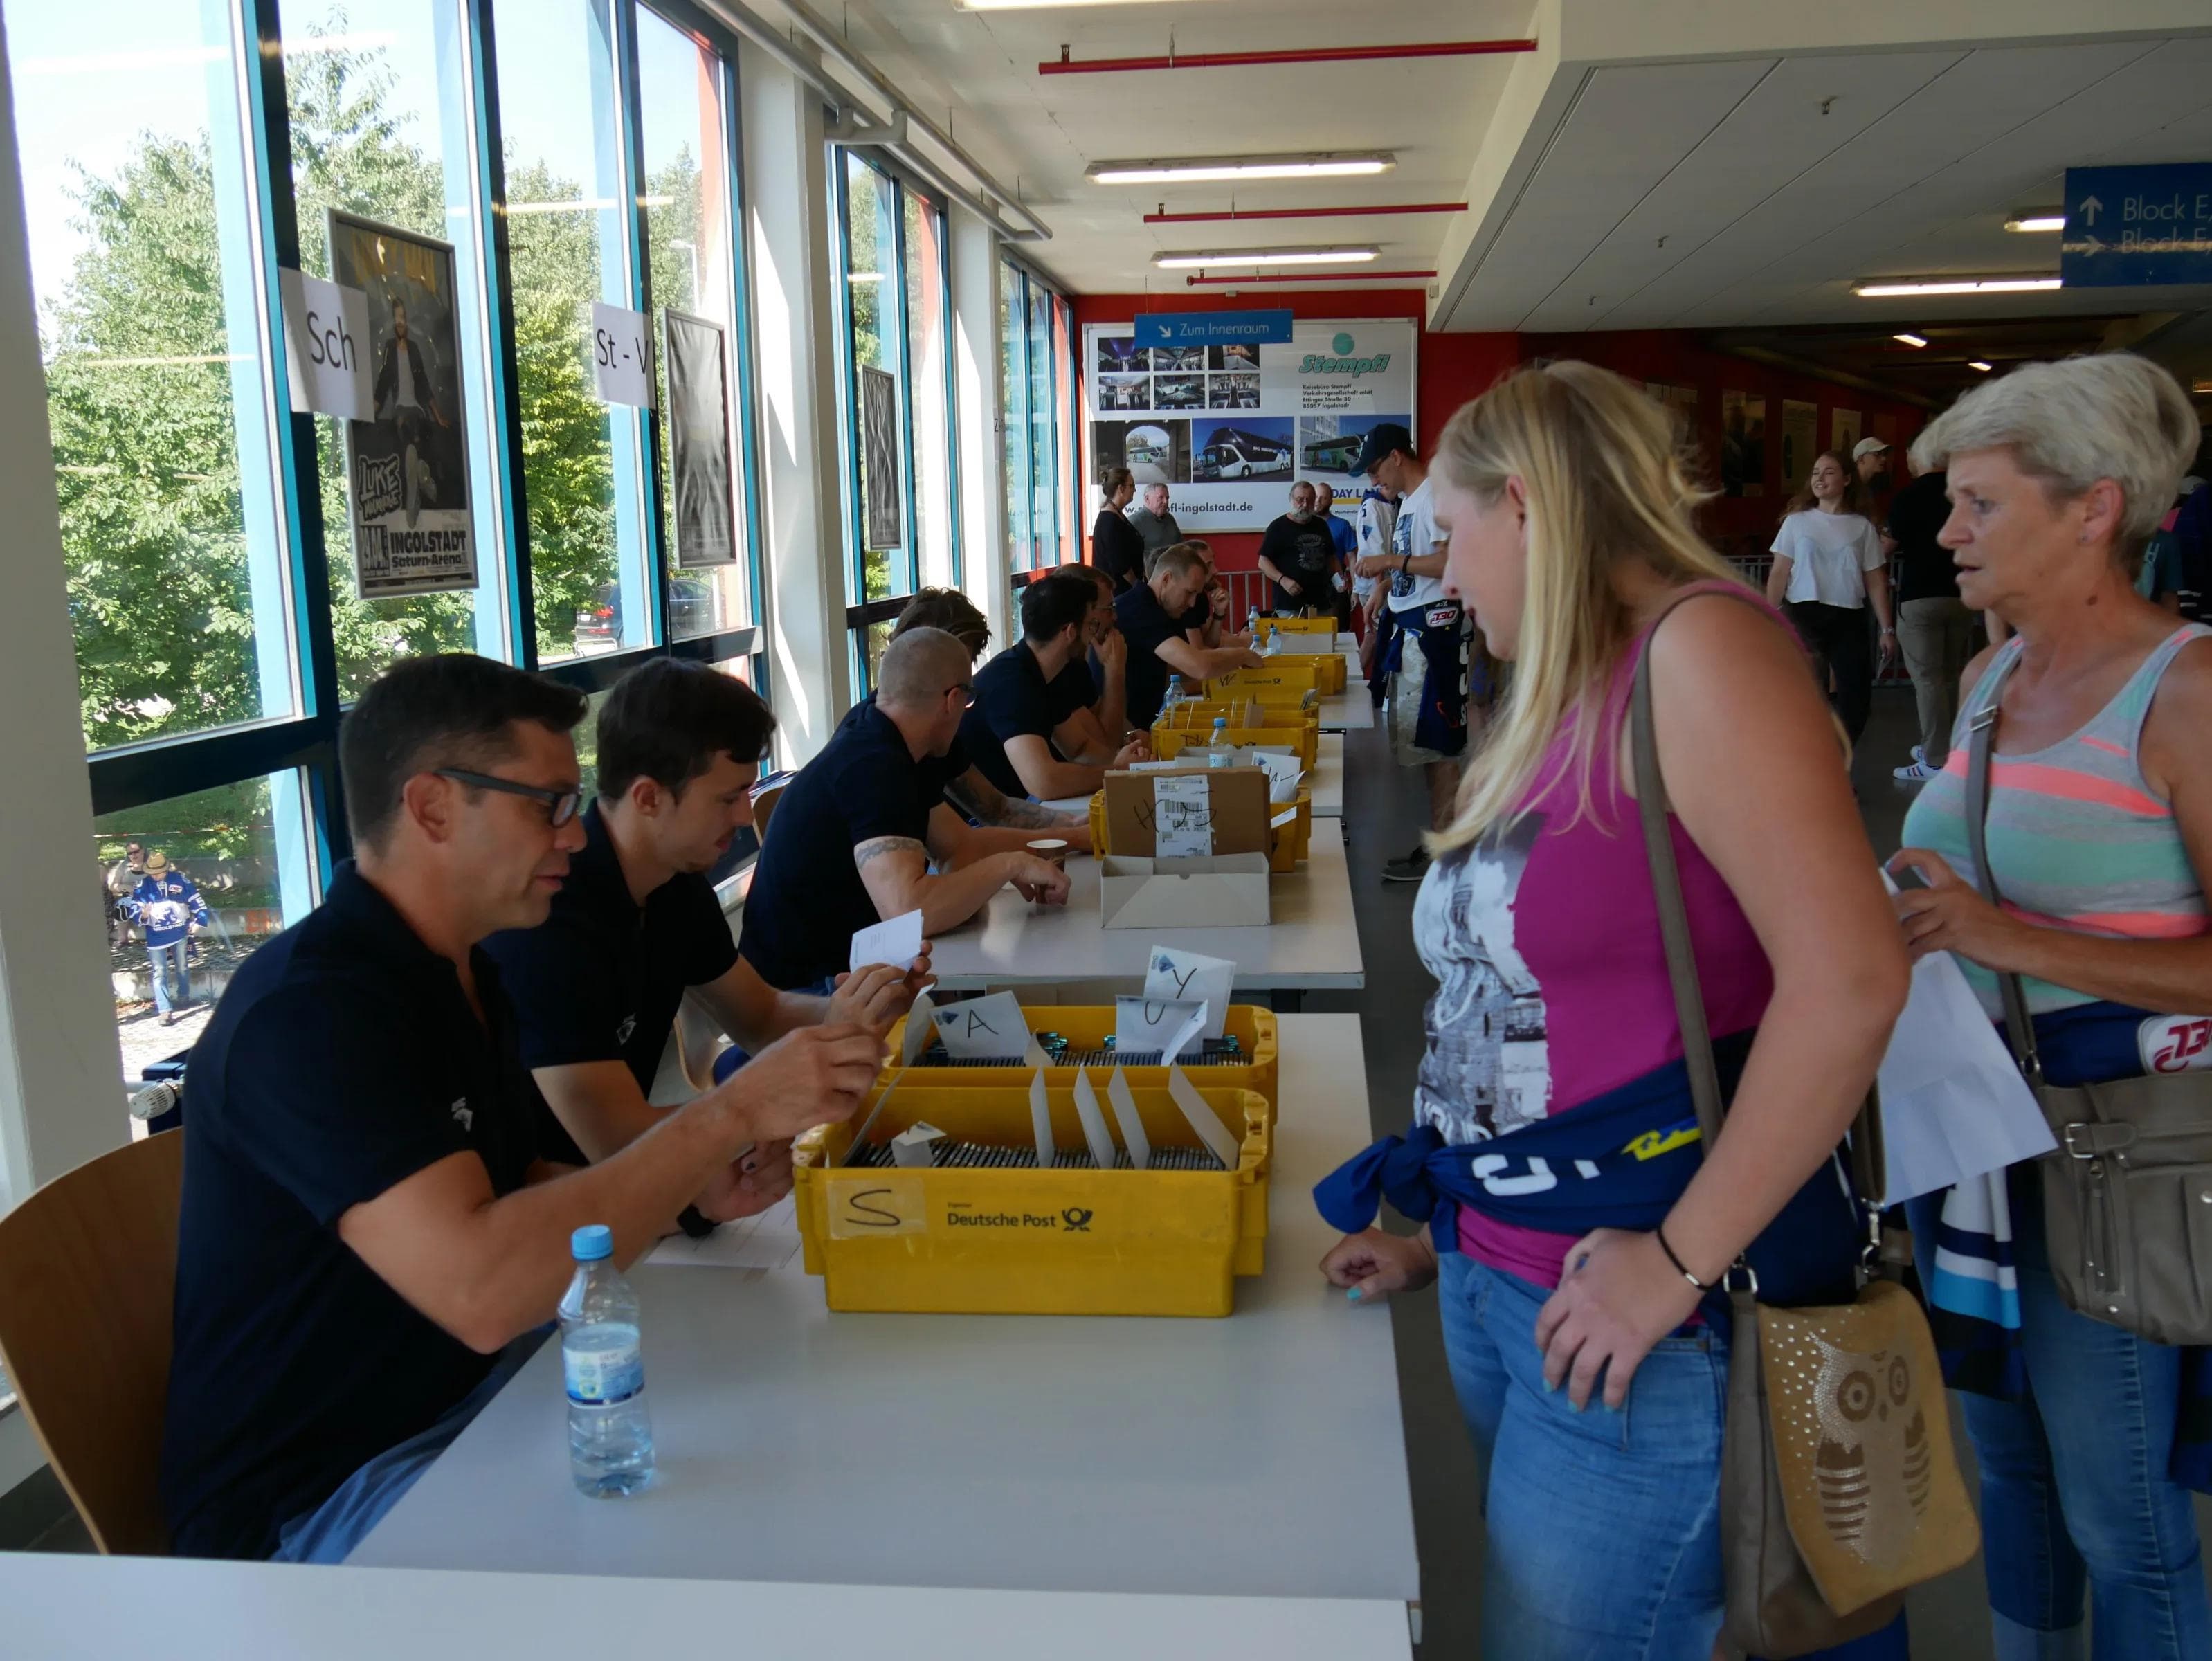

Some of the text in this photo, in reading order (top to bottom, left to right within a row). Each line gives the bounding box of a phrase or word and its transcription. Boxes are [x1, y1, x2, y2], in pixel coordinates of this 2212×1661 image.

[2123, 194, 2186, 221] Block
[2121, 227, 2184, 253] Block
[307, 311, 357, 373] Sch
[1179, 322, 1269, 336] Zum Innenraum
[597, 328, 617, 369] St
[1298, 354, 1391, 379] Stempfl
[359, 458, 399, 502] LUKE
[1332, 488, 1353, 498] DAY
[390, 530, 466, 554] INGOLSTADT
[392, 554, 462, 568] Saturn-Arena
[1172, 968, 1197, 999] Y
[967, 1009, 999, 1038] A
[845, 1188, 901, 1226] S
[948, 1213, 1056, 1227] Deutsche Post
